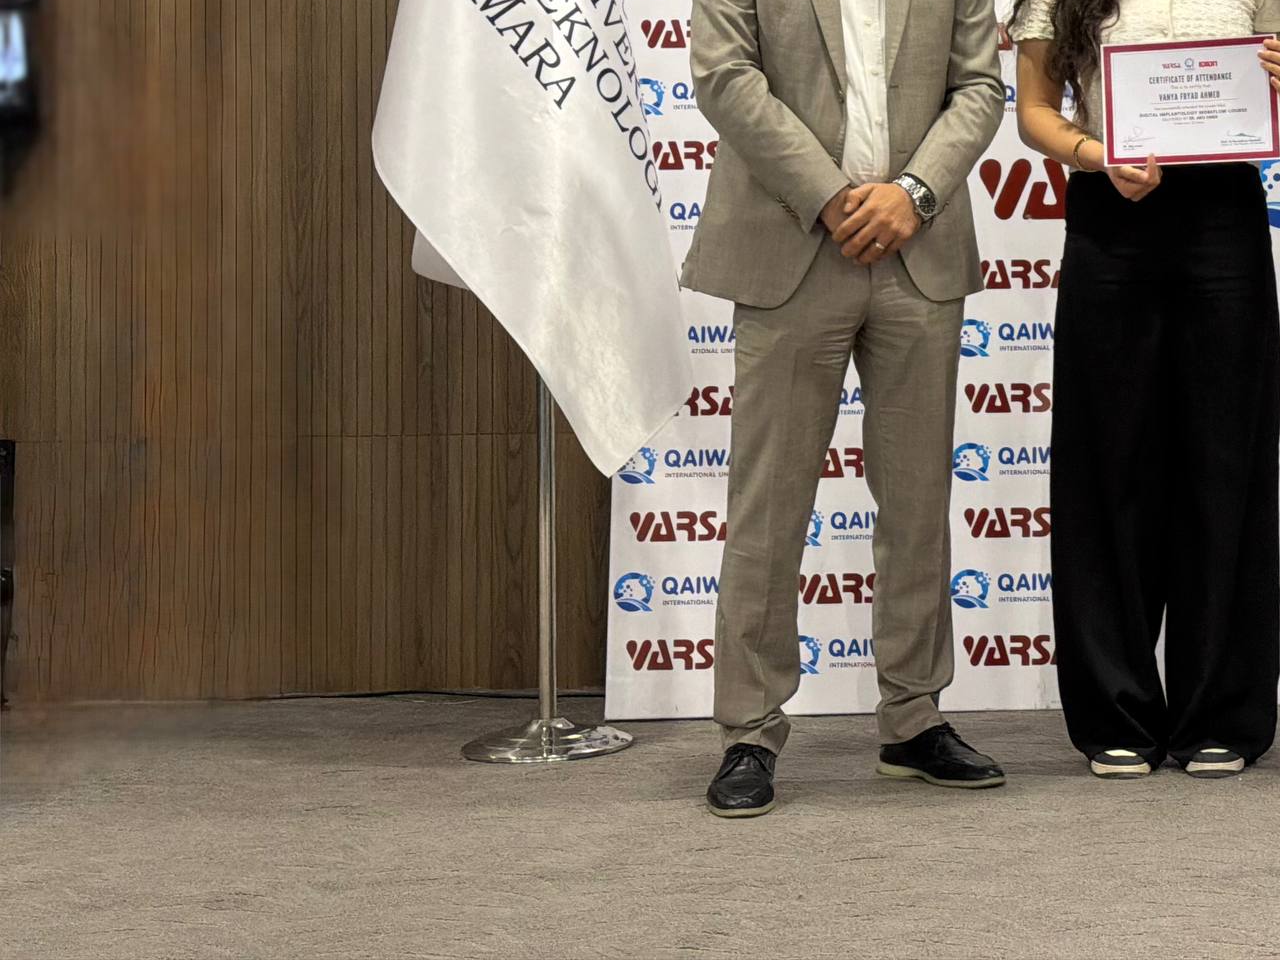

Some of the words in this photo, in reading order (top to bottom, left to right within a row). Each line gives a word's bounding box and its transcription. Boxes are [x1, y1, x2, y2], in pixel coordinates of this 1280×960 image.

[1149, 75, 1185, 84] CERTIFICATE
[1187, 74, 1194, 82] OF
[1195, 72, 1232, 82] ATTENDANCE
[998, 323, 1054, 341] QAIW
[964, 383, 1051, 414] VARS
[664, 450, 730, 468] QAIW
[630, 511, 728, 542] VARS
[831, 511, 878, 530] QAI
[964, 507, 1051, 538] VARS
[662, 577, 719, 595] QAIW
[626, 639, 714, 670] VARS
[828, 639, 876, 657] QAI
[963, 635, 1057, 666] VARS
